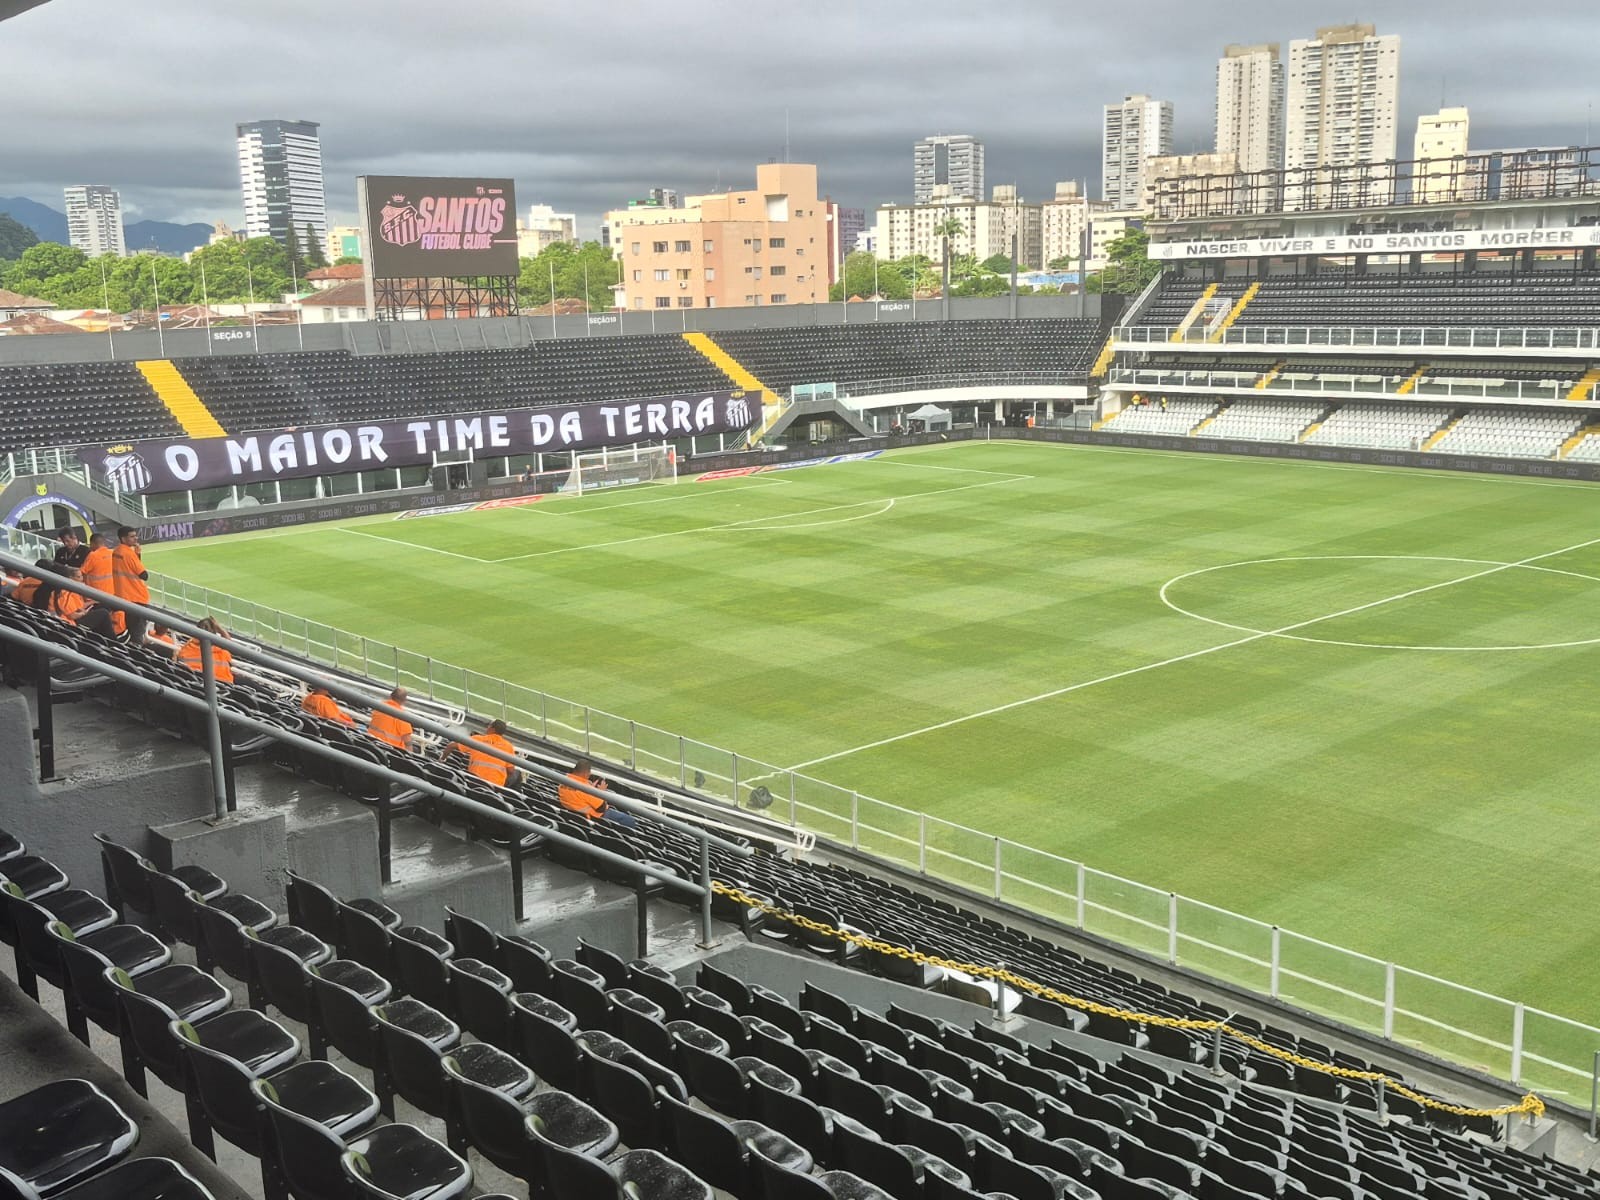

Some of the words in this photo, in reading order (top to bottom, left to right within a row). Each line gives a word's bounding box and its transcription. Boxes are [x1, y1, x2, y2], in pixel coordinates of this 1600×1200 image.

[419, 197, 506, 233] SANTOS
[421, 233, 461, 250] FUTEBOL
[463, 233, 493, 249] CLUBE
[1259, 240, 1313, 252] VIVER
[1326, 238, 1336, 250] E
[1348, 237, 1374, 249] NO
[1386, 234, 1465, 248] SANTOS
[1480, 230, 1574, 246] MORRER
[213, 330, 244, 342] SEÇÃO
[165, 445, 199, 482] O
[225, 425, 389, 475] MAIOR
[407, 415, 511, 455] TIME
[530, 411, 584, 446] DA
[600, 396, 715, 437] TERRA
